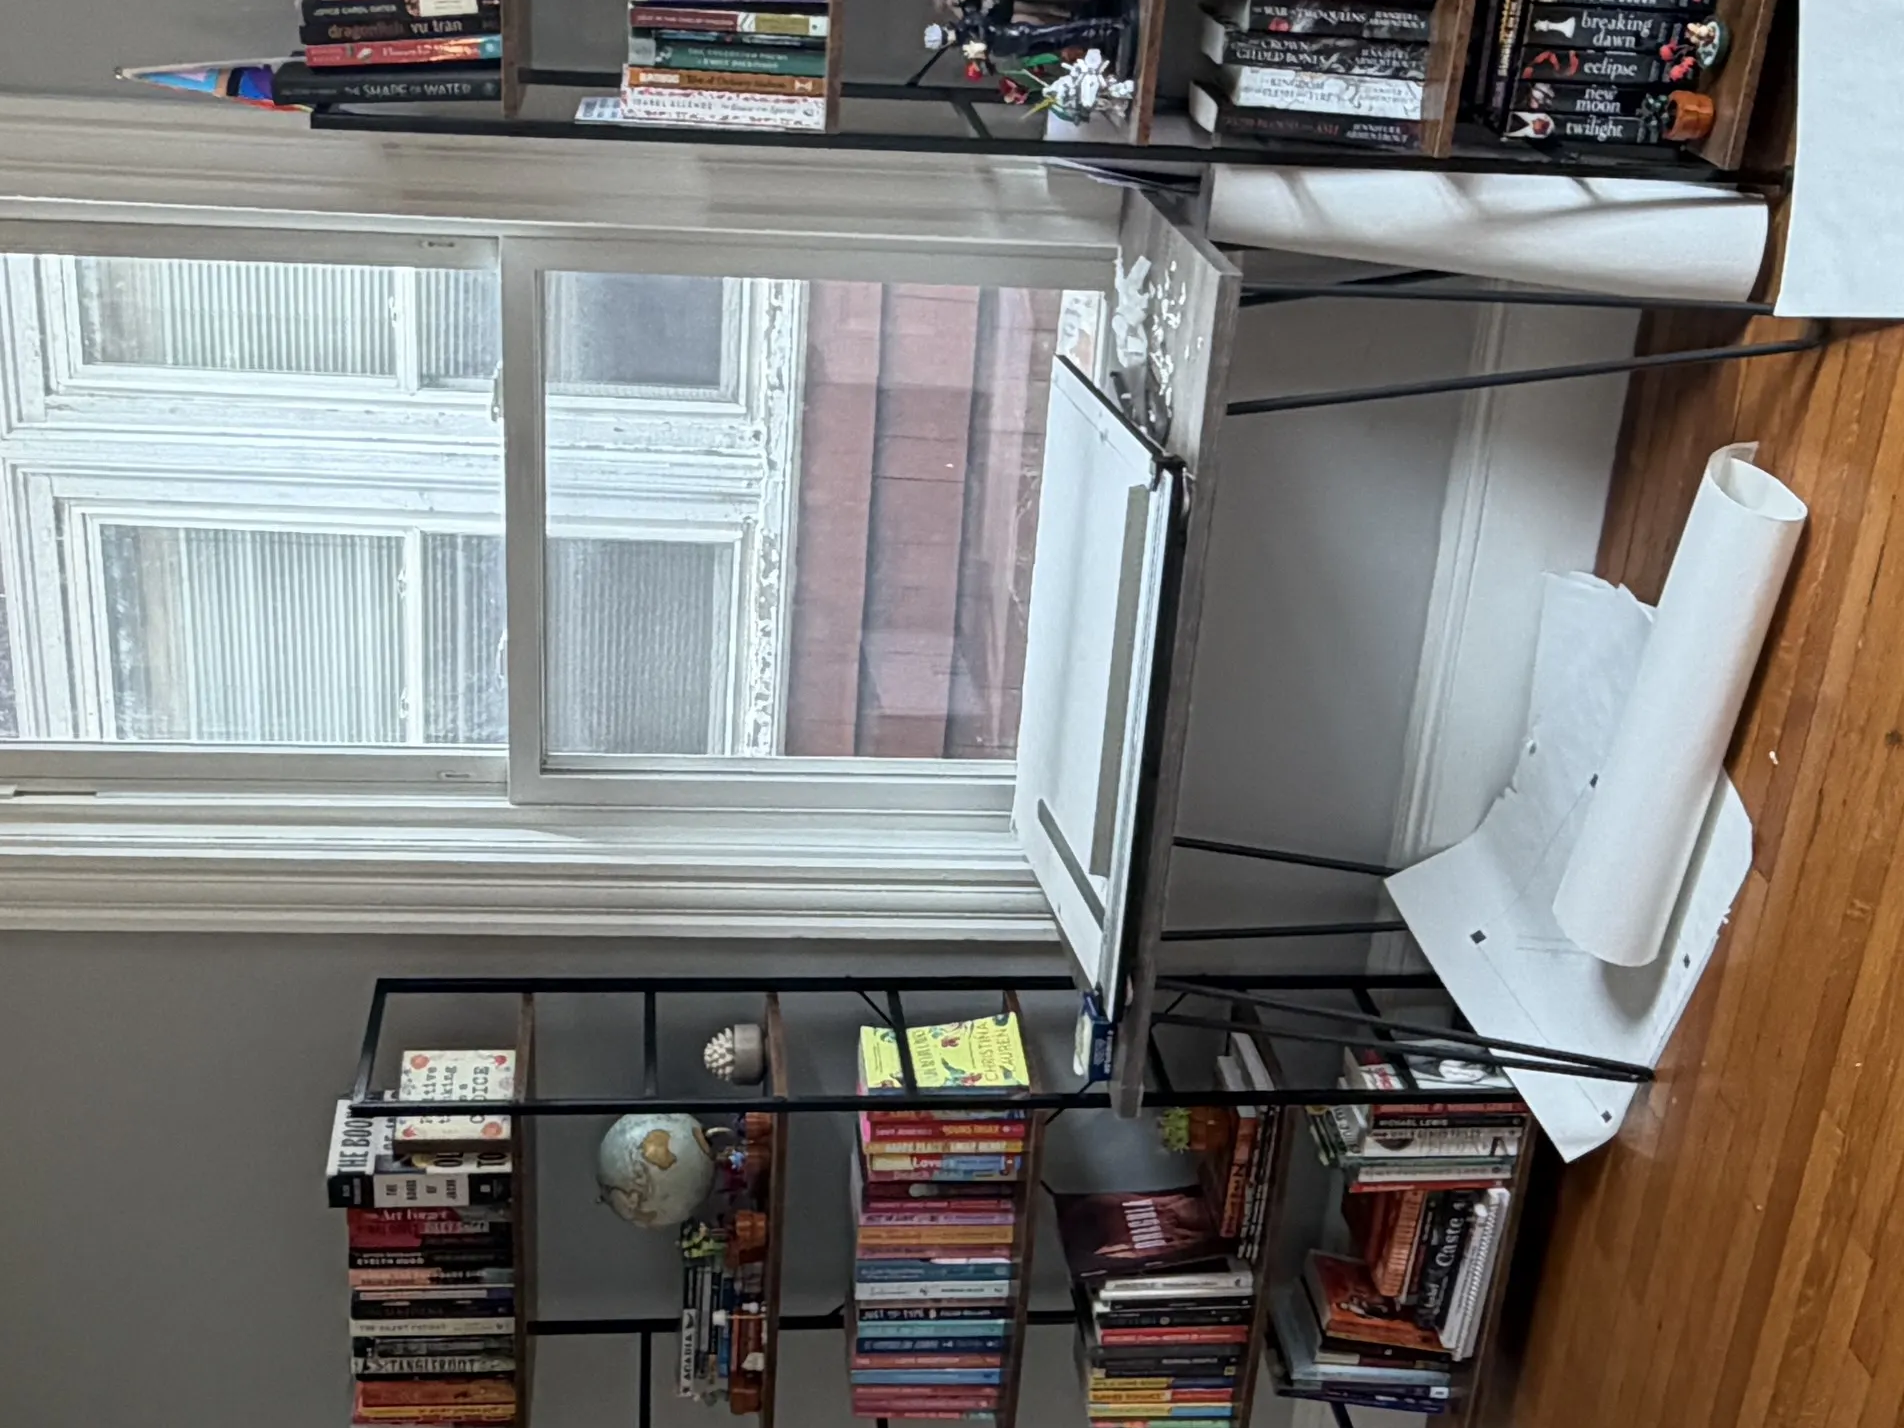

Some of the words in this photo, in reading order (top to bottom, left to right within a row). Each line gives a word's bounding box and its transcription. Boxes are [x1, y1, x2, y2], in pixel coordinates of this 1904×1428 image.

[1581, 11, 1652, 38] breaking
[1592, 32, 1636, 49] dawn
[1583, 57, 1638, 80] eclipse
[1585, 86, 1618, 101] new
[1576, 99, 1622, 113] moon
[1566, 117, 1623, 141] twilight
[977, 1021, 999, 1082] CHRISTINA
[1435, 1217, 1464, 1267] Caste
